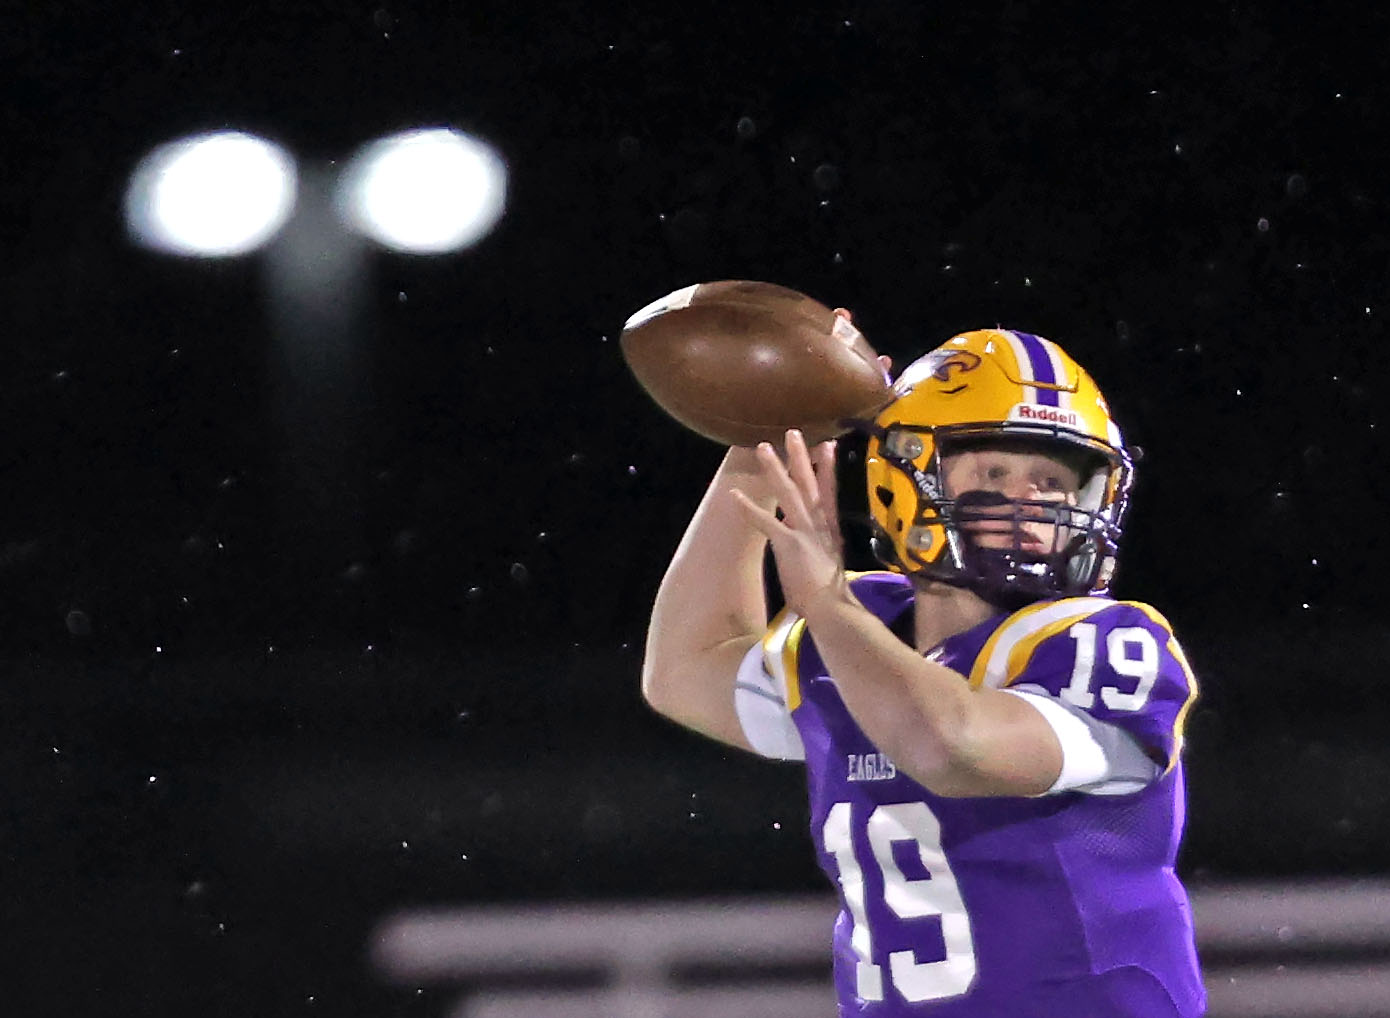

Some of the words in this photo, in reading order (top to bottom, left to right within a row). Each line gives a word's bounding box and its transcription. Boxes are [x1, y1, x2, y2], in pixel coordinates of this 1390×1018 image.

[1019, 405, 1077, 425] Riddell
[1059, 623, 1159, 711] 19
[822, 801, 977, 1003] 19
